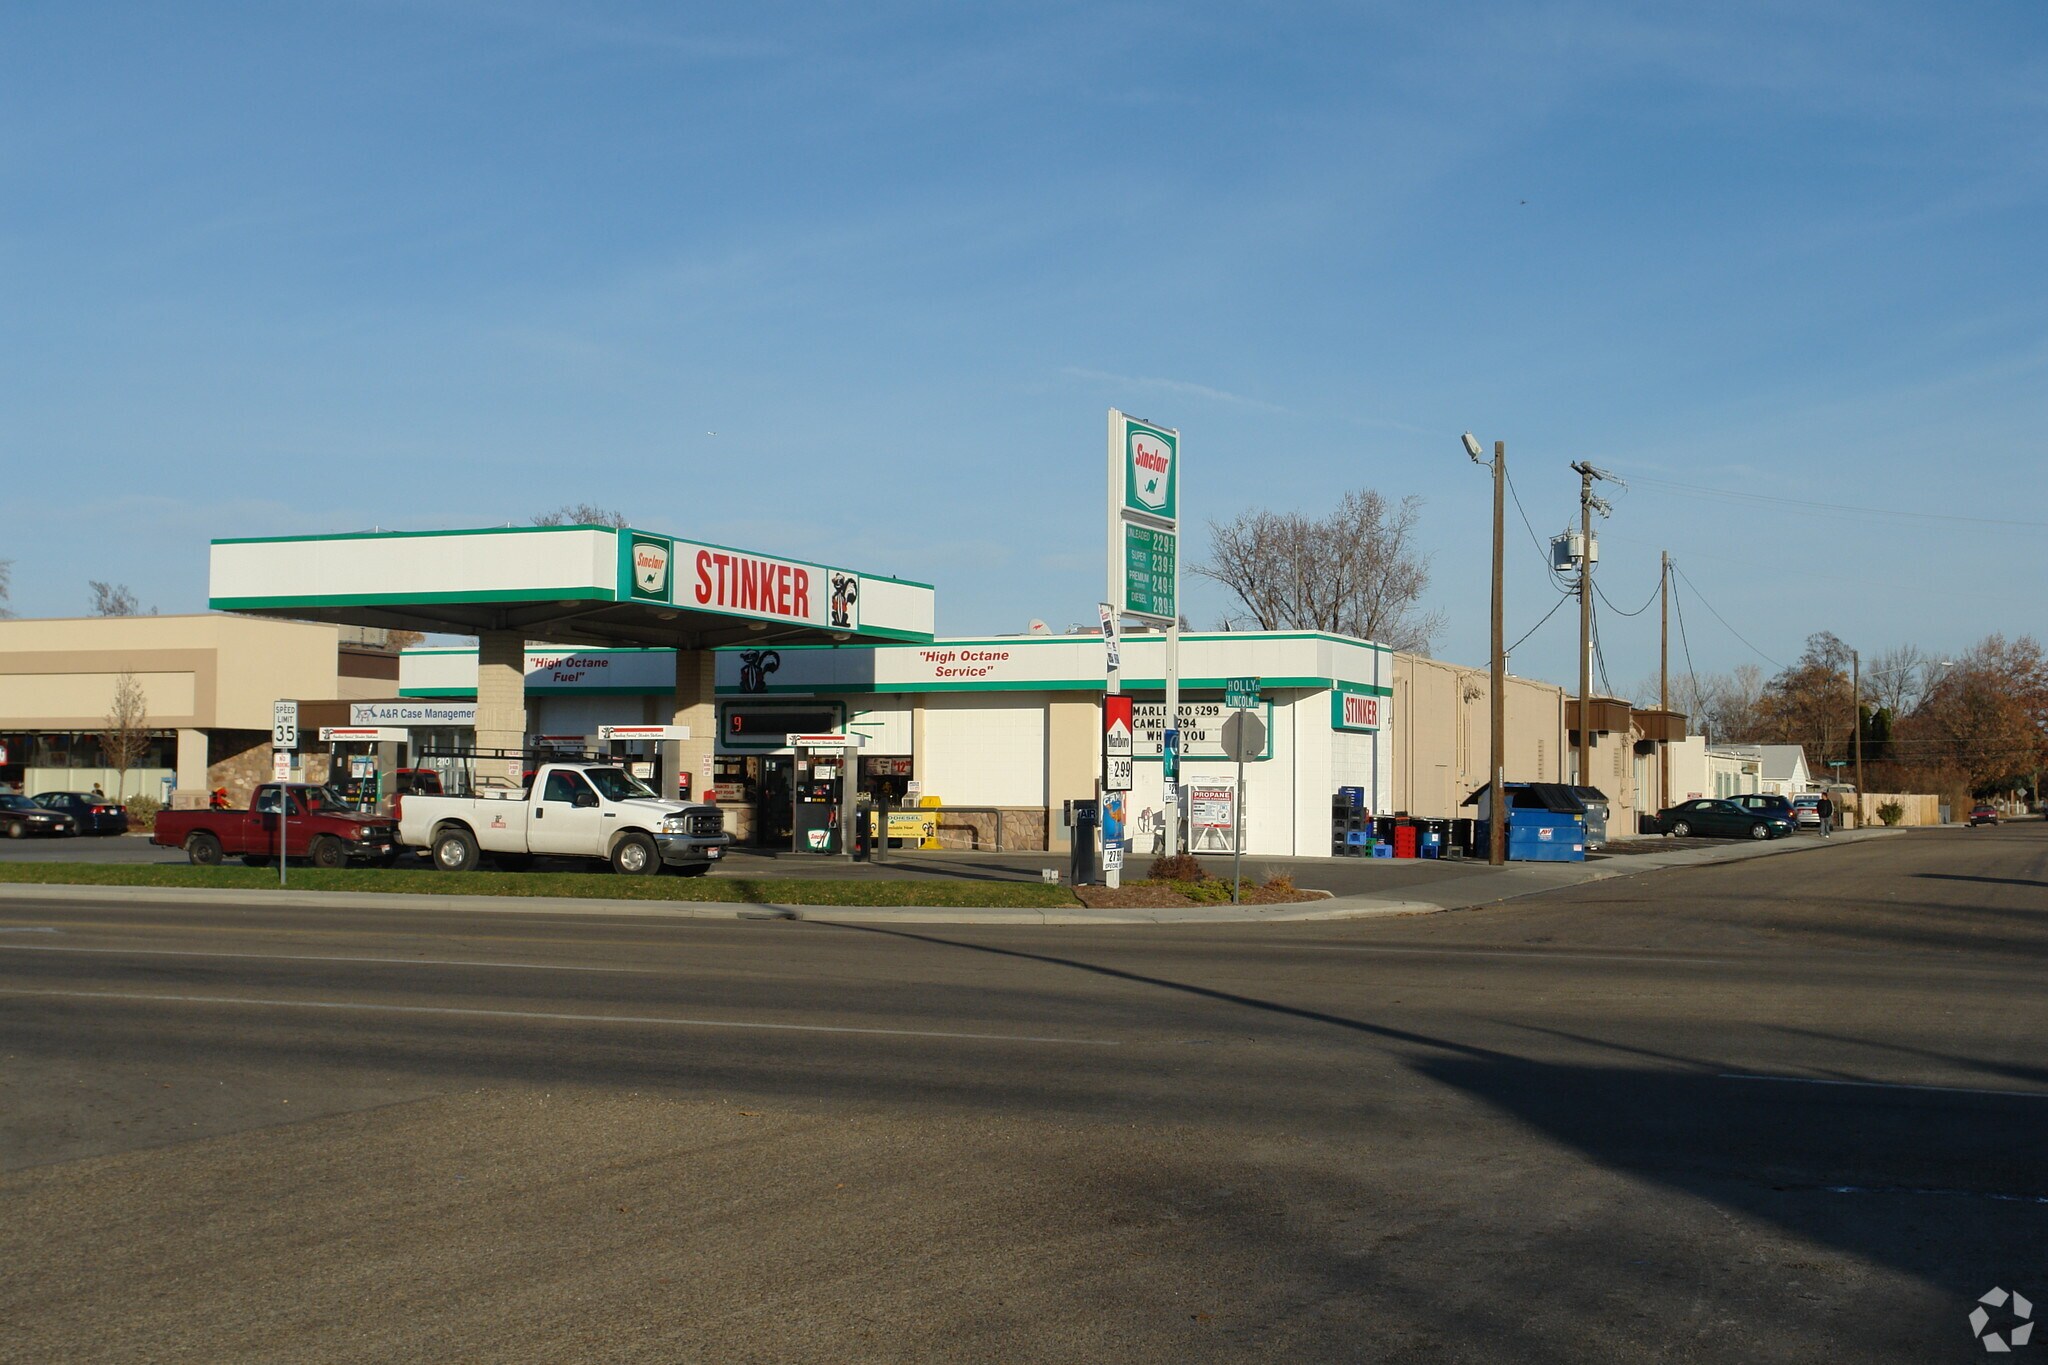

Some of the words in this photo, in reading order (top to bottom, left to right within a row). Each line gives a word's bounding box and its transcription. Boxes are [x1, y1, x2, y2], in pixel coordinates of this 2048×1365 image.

[1135, 443, 1168, 473] Sinclair
[1128, 527, 1150, 541] UNLEADED
[1152, 533, 1169, 553] 229
[637, 552, 664, 570] Sinclair
[1131, 549, 1146, 562] SUPER
[1152, 554, 1168, 573] 239
[695, 549, 809, 618] STINKER
[1129, 570, 1149, 583] PREMIUM
[1152, 575, 1168, 594] 249
[1131, 592, 1147, 604] DIESEL
[1153, 596, 1169, 615] 289
[530, 657, 562, 670] "High
[566, 657, 609, 668] Octane
[919, 650, 956, 664] "High
[960, 650, 1009, 661] Octane
[553, 671, 586, 682] Fuel"
[935, 665, 994, 677] Service"
[1228, 680, 1256, 691] HOLLY
[1229, 695, 1254, 707] LINCOLN
[275, 706, 295, 714] SPEED
[379, 708, 399, 719] A&R
[400, 708, 422, 719] Case
[425, 708, 475, 721] Managemen
[1195, 705, 1219, 716] $299
[1345, 697, 1377, 725] STINKER
[275, 725, 295, 742] 35
[1108, 730, 1129, 747] Marlboro
[1183, 731, 1206, 741] YOU
[1183, 744, 1190, 753] 2
[437, 757, 450, 766] 210
[1080, 809, 1096, 818] AIR
